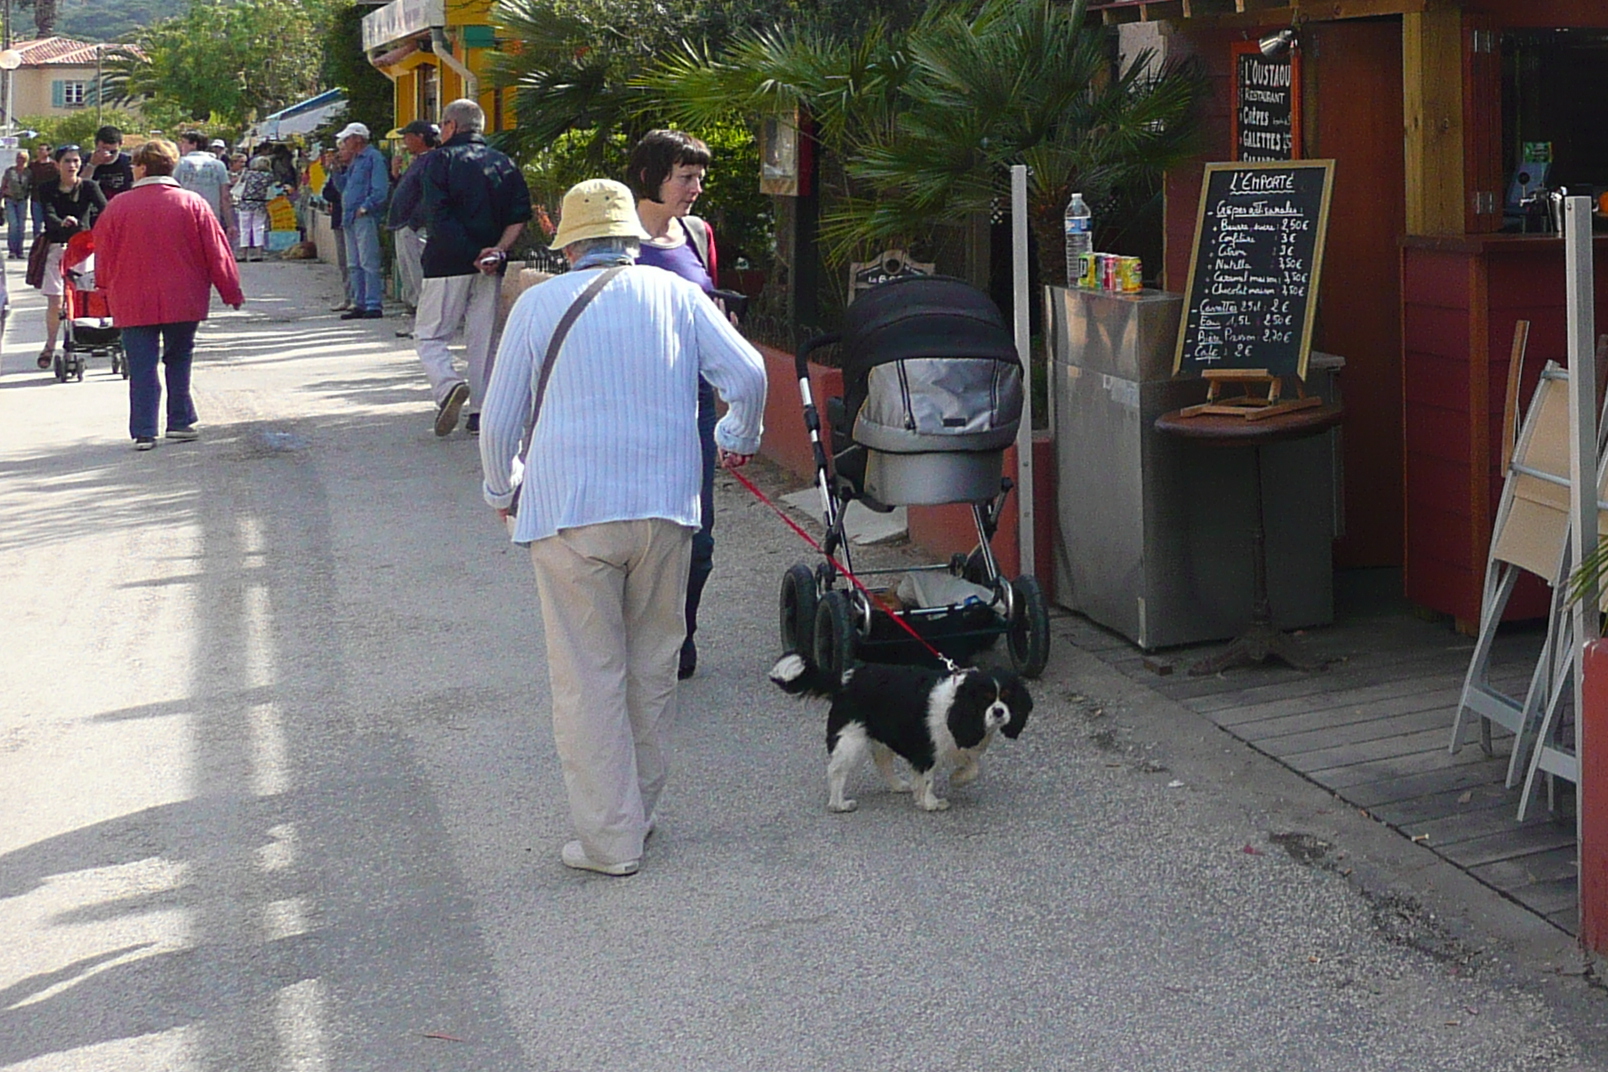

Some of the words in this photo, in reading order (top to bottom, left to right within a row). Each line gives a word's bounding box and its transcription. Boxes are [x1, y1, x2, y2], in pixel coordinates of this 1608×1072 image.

[1244, 59, 1291, 87] L'OUSTAOU
[1244, 87, 1285, 104] RESTAURANT
[1243, 106, 1270, 126] CRÊPES
[1243, 130, 1281, 151] GALETTES
